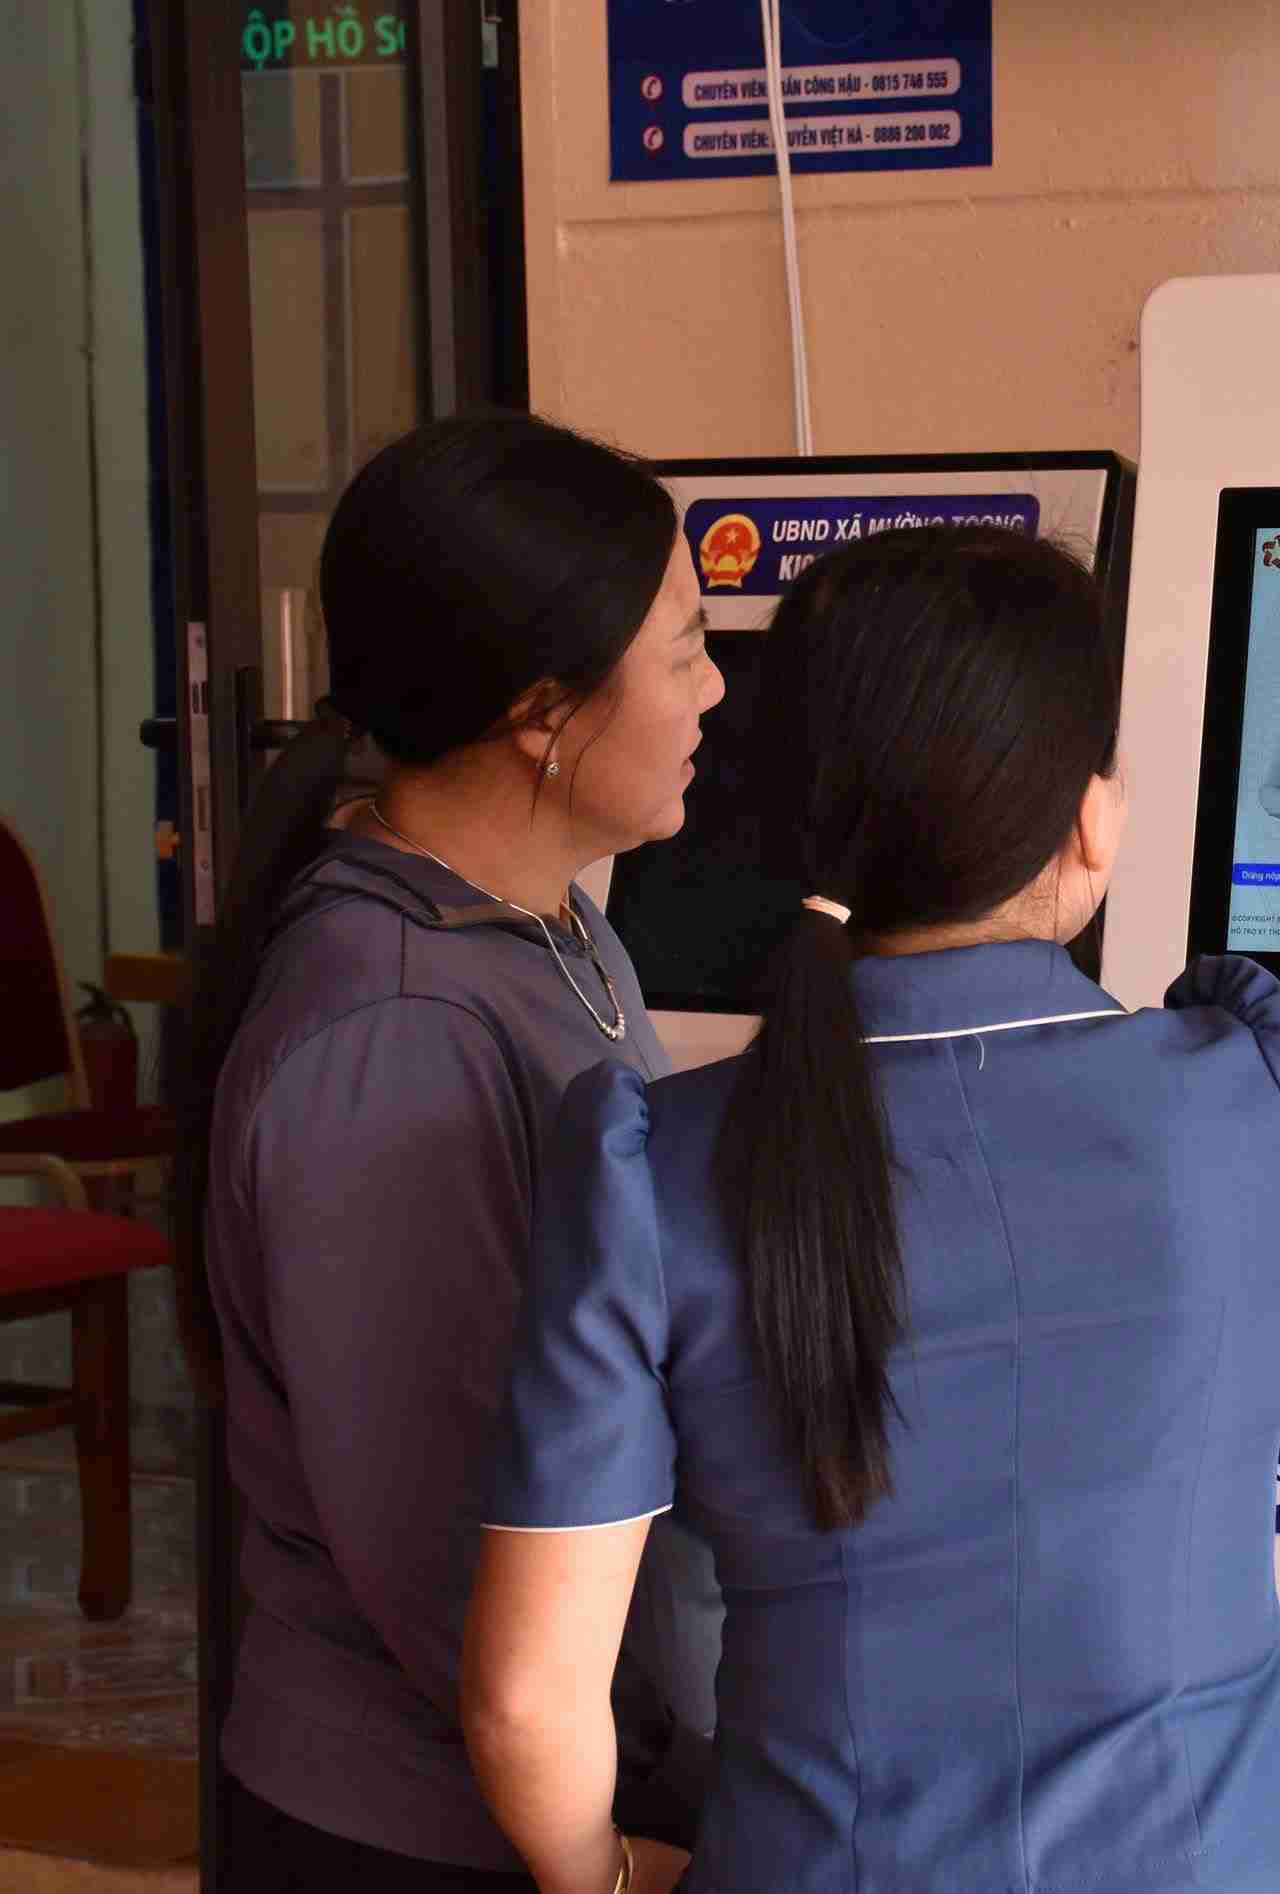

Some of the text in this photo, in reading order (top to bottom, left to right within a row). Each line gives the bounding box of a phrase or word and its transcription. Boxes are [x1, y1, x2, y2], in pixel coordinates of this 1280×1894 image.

[242, 9, 296, 72] ỘP
[305, 4, 365, 60] HỒ
[772, 520, 829, 543] UBND
[834, 513, 862, 541] XÃ
